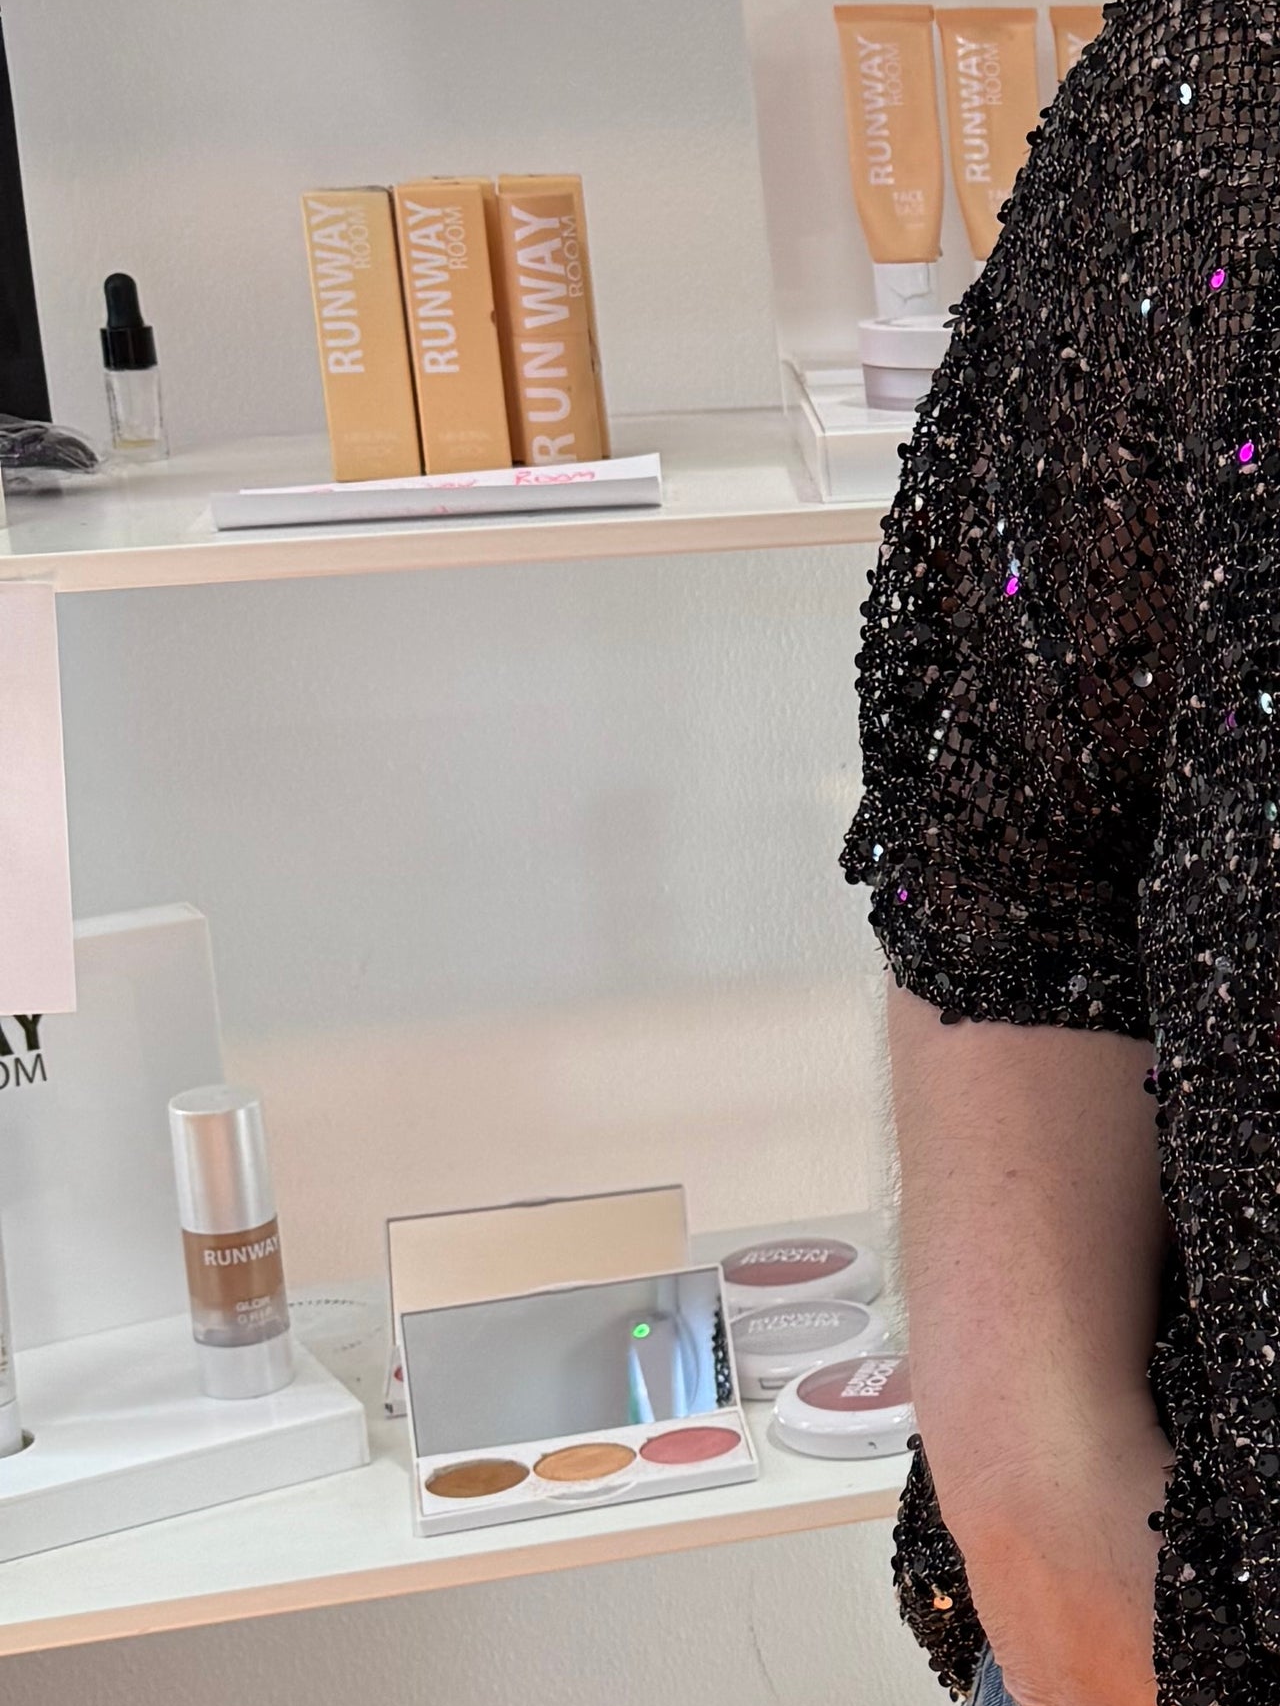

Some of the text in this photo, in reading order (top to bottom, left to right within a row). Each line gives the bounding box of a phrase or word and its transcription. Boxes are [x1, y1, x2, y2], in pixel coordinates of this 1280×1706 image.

[856, 34, 896, 185] RUNWAY
[955, 34, 992, 184] RUNWAY
[310, 201, 365, 374] RUNWAY
[348, 206, 372, 270] ROOM
[406, 201, 461, 374] RUNWAY
[444, 206, 469, 270] ROOM
[560, 214, 585, 298] ROOM
